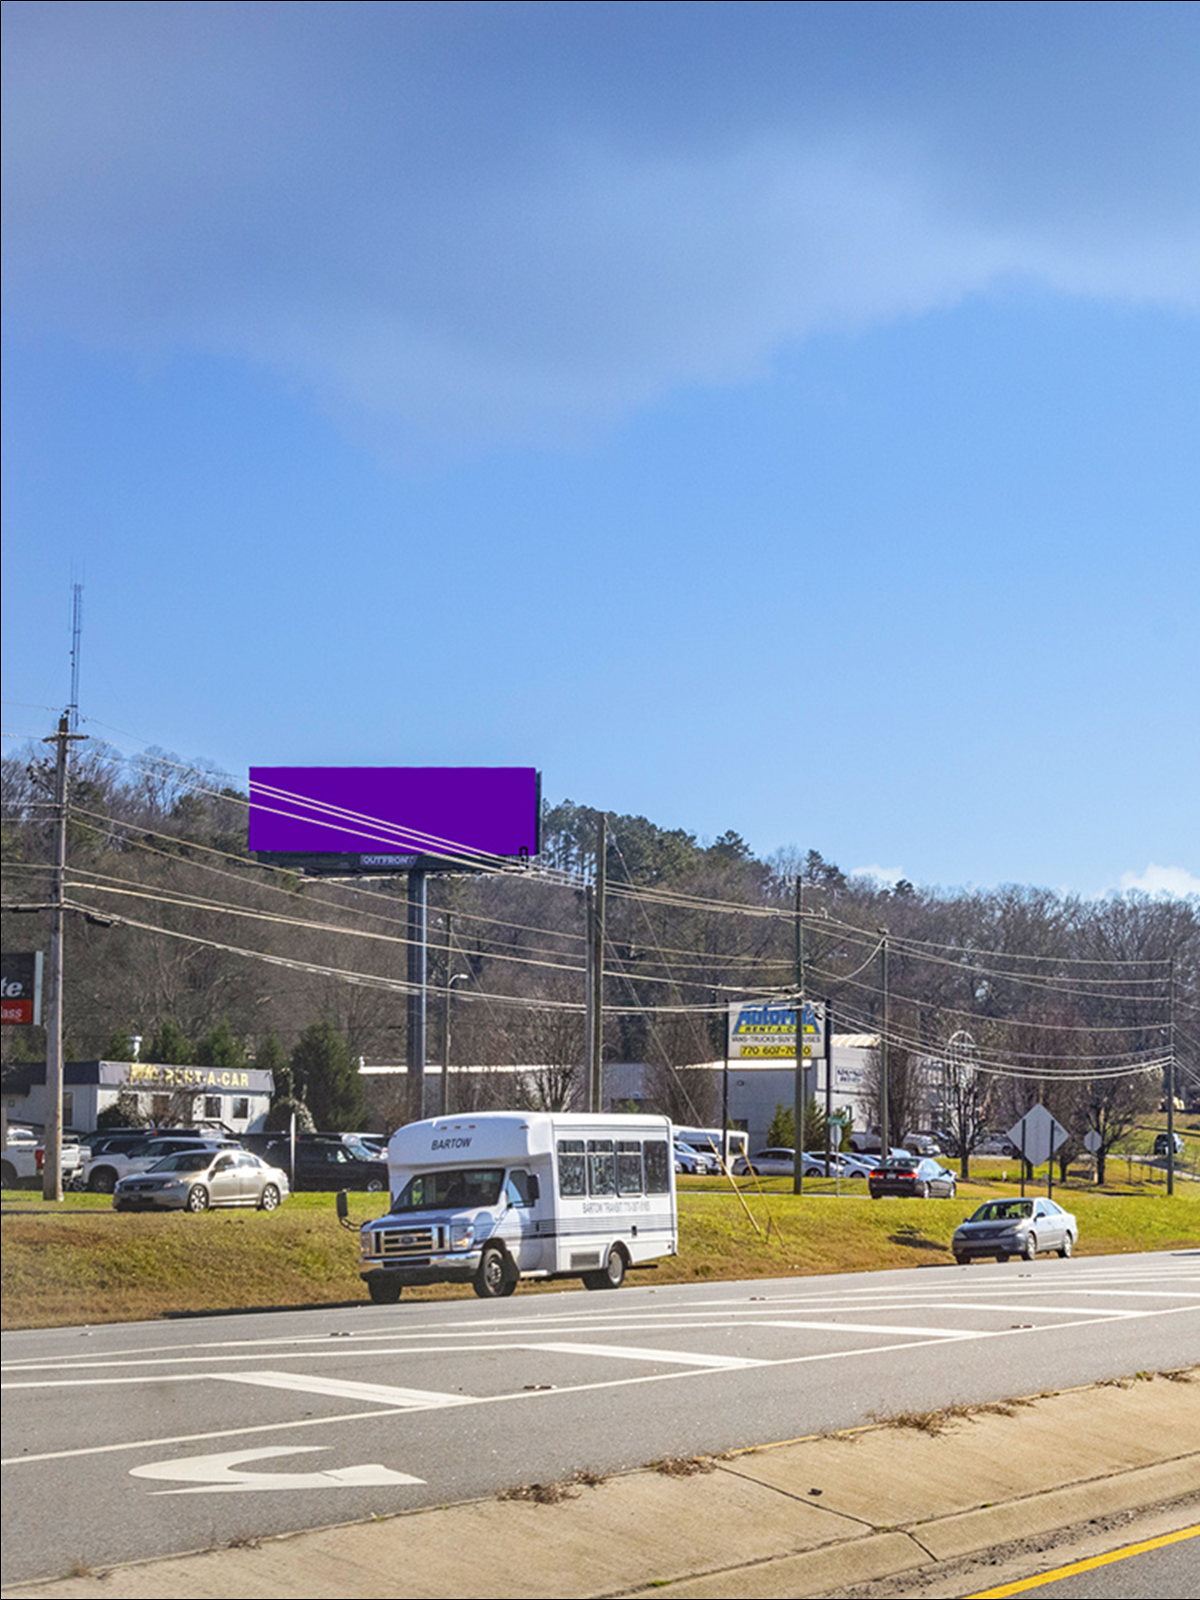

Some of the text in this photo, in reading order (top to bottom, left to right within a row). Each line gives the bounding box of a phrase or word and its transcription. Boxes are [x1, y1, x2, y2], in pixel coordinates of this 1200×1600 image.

[742, 1046, 811, 1055] 770 607-700
[431, 1138, 472, 1151] BARTOW
